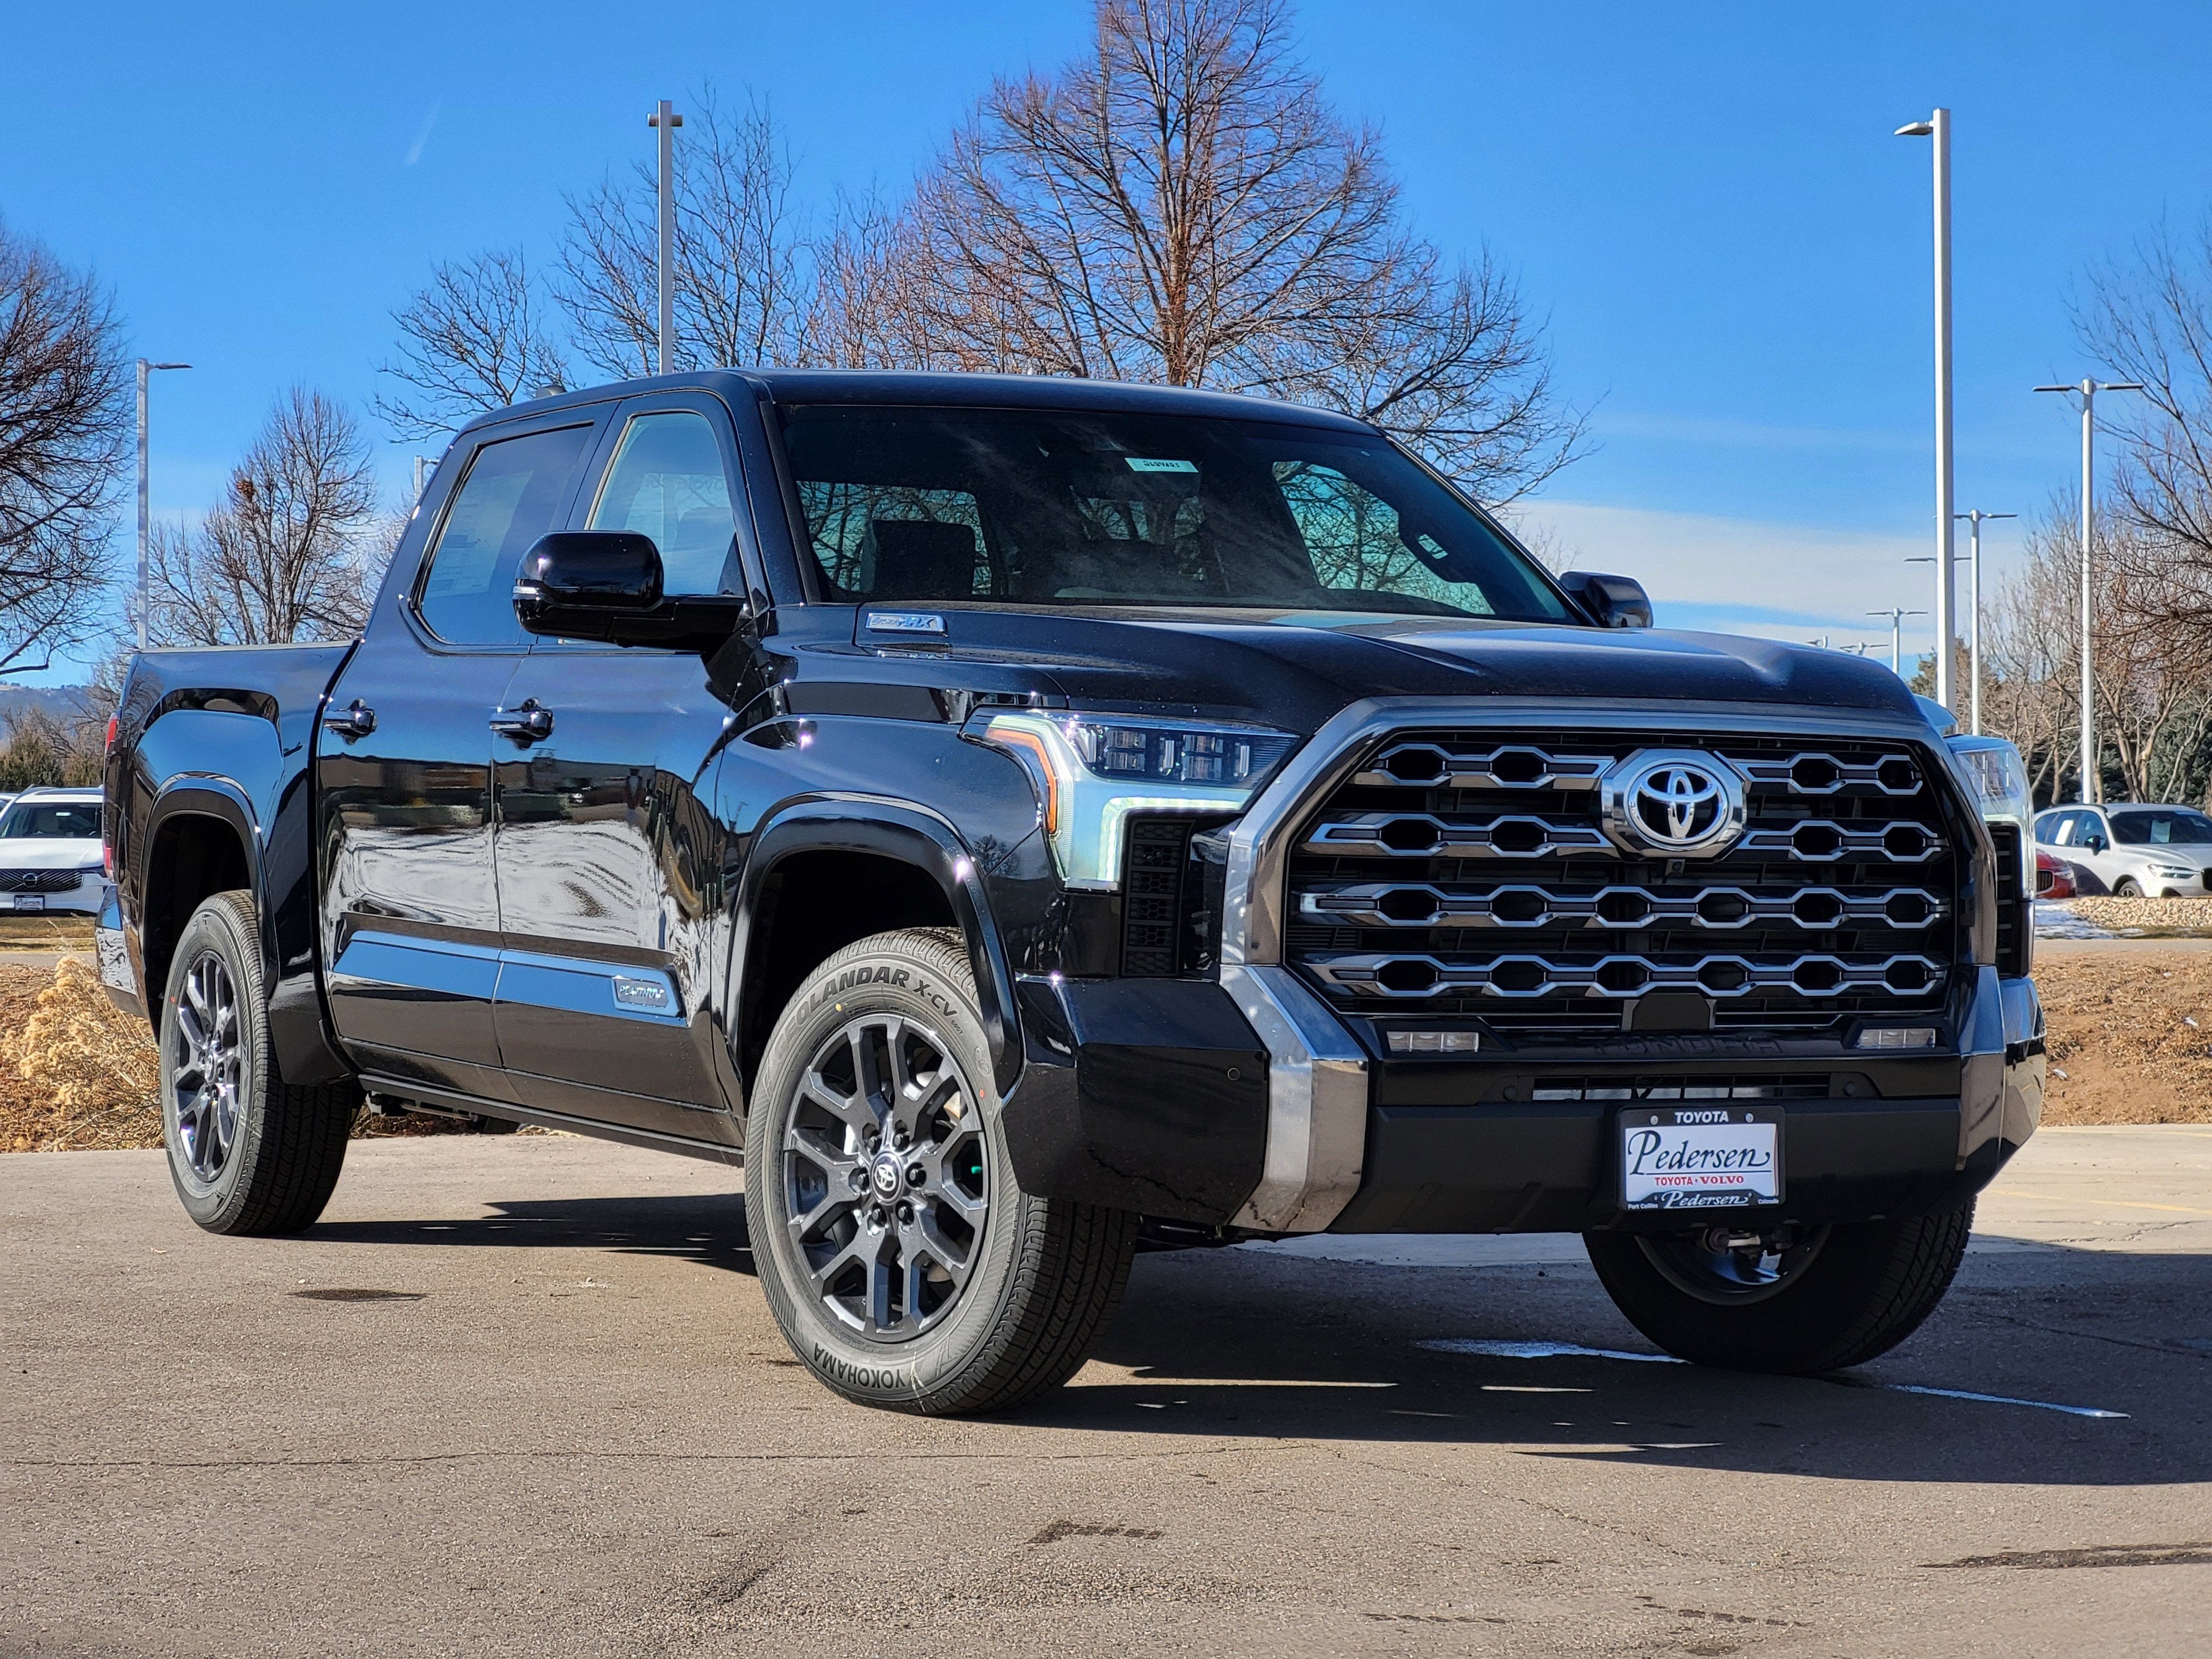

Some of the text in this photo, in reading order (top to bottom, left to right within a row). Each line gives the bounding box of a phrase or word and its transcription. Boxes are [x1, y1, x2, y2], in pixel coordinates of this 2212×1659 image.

[619, 985, 665, 999] PLATINUM
[913, 979, 957, 1016] X-CV
[1674, 1111, 1729, 1124] TOYOTA
[1627, 1130, 1771, 1175] Pedersen
[1655, 1176, 1744, 1186] TOYOTA VOLVO
[1661, 1190, 1749, 1209] Pedersen
[814, 1342, 905, 1389] YOKOHAMA
